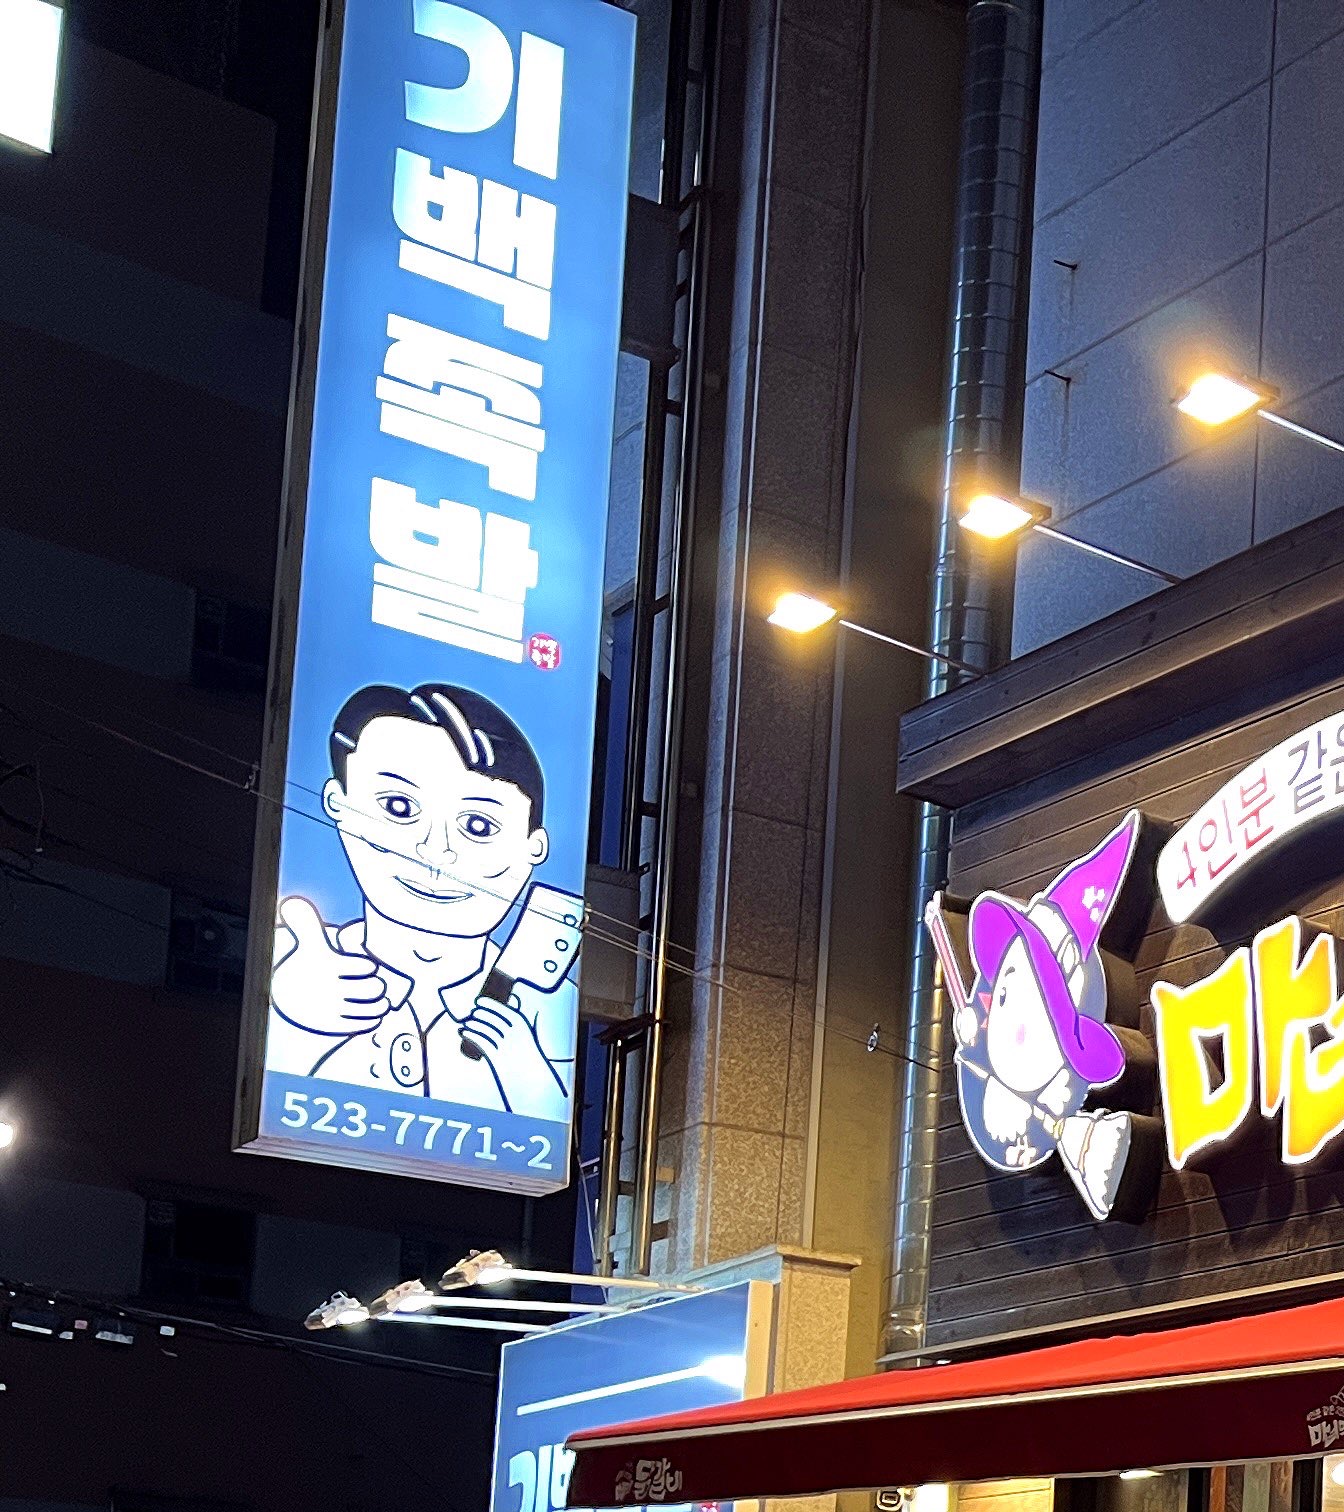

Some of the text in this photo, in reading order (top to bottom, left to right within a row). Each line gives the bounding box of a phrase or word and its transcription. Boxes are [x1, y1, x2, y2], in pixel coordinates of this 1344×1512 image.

[368, 0, 565, 664] 기백족발
[1176, 776, 1275, 891] 4인분
[280, 1091, 552, 1171] 523-7771~2
